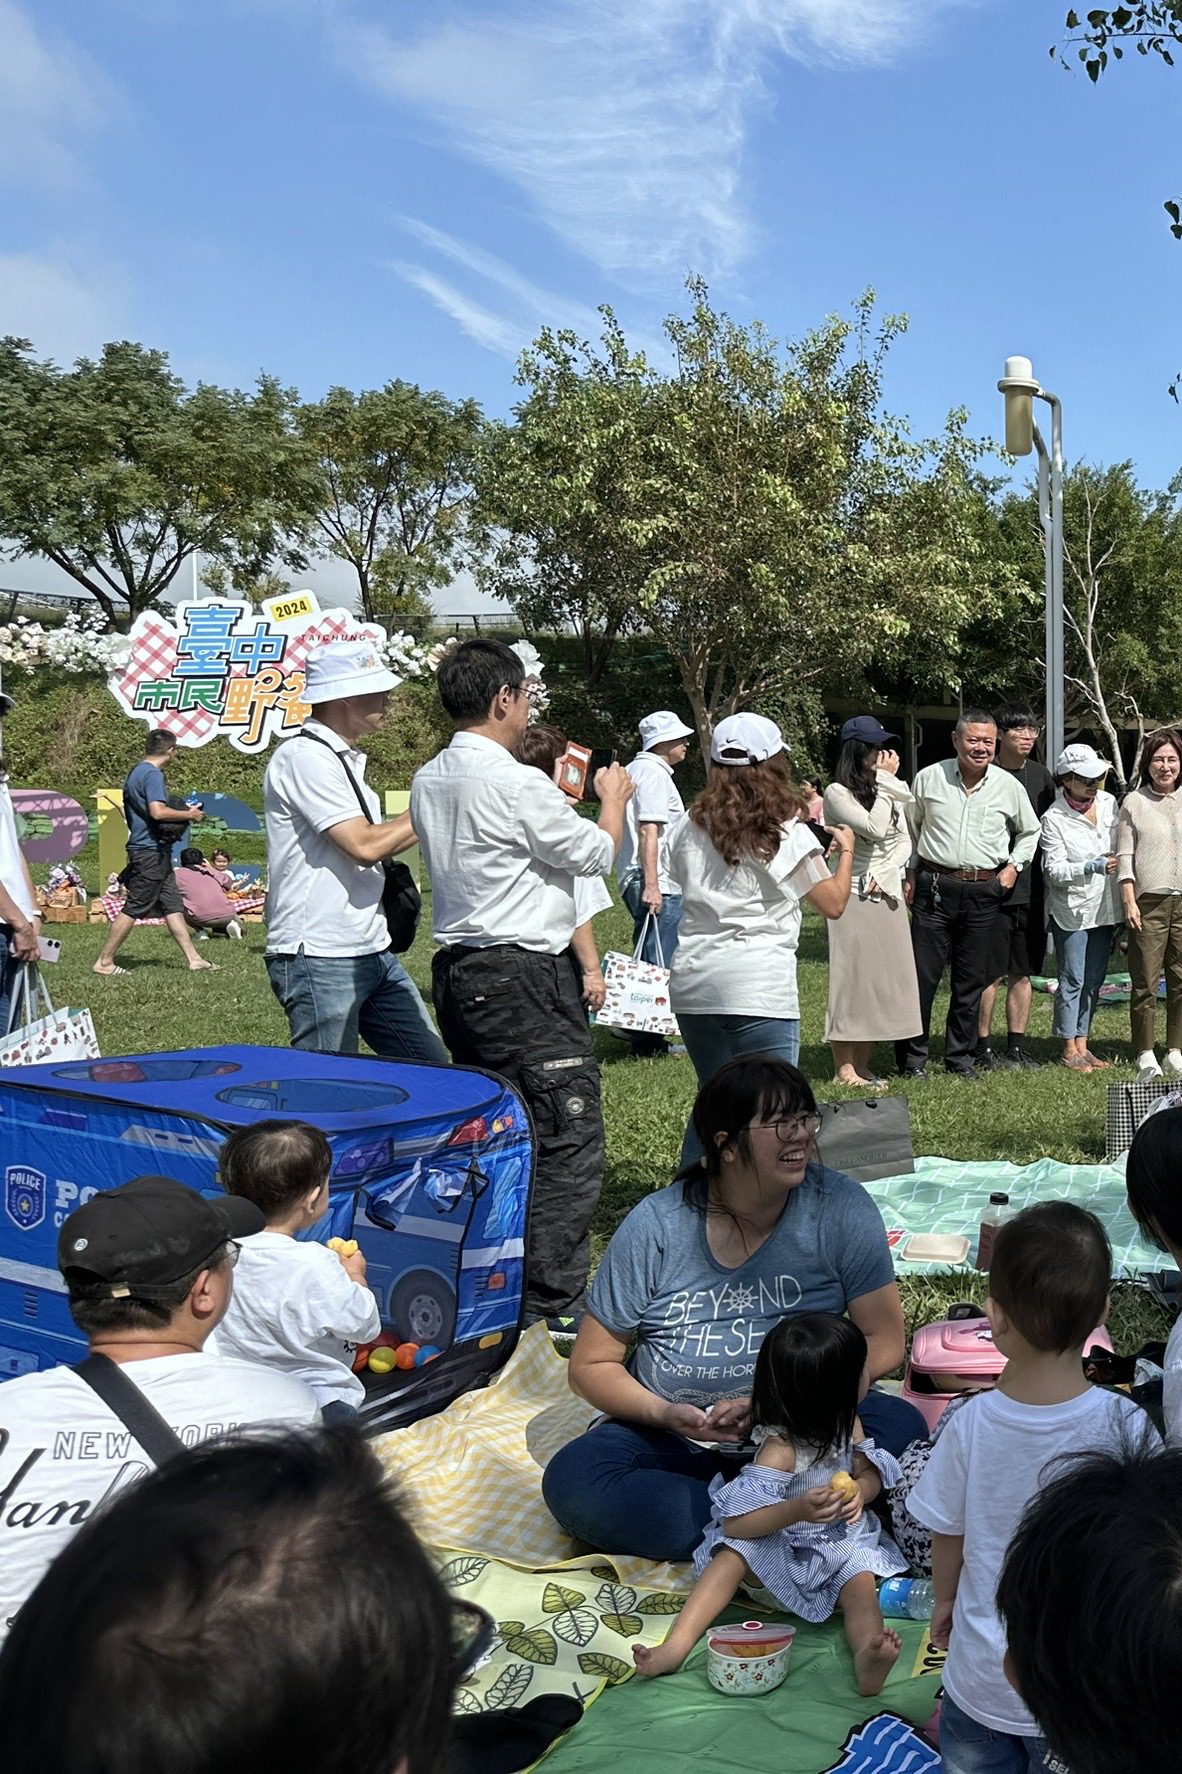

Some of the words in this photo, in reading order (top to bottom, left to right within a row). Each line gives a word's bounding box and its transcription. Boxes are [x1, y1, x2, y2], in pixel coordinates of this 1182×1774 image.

[275, 600, 309, 620] 2024
[173, 604, 287, 677] 臺中
[300, 633, 367, 643] TAICHUNG
[10, 1172, 42, 1191] POLICE
[725, 1315, 786, 1357] SE
[661, 1360, 693, 1378] OVER
[696, 1366, 720, 1379] THE
[722, 1363, 756, 1378] HOR
[53, 1431, 132, 1460] NEW
